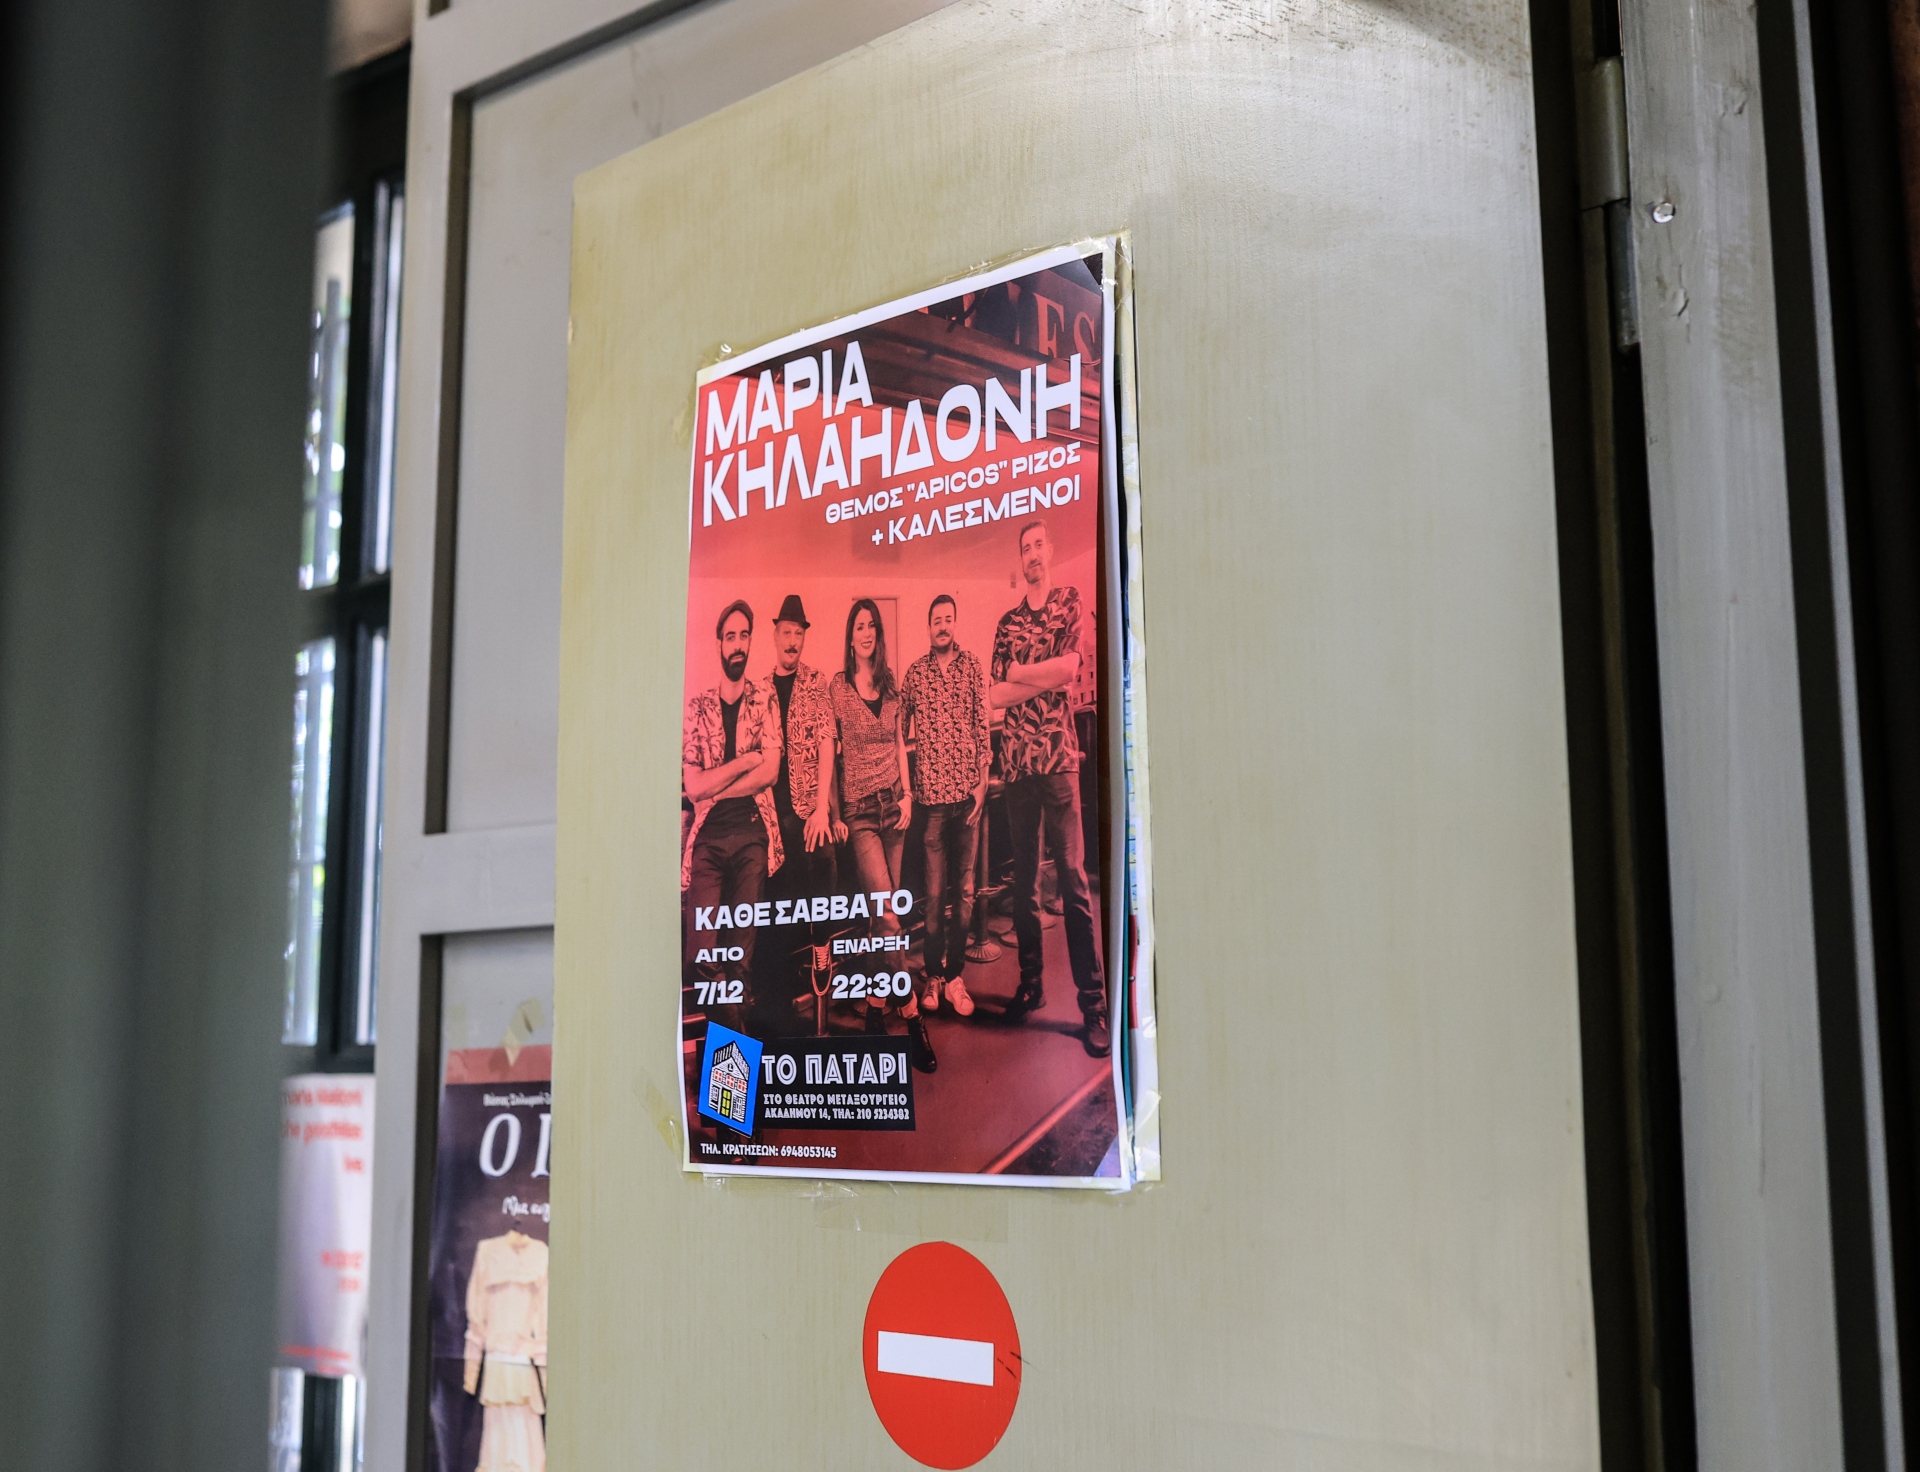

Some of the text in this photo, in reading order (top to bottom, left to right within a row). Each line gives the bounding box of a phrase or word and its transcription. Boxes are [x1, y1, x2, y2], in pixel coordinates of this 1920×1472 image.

[705, 340, 873, 456] ΜΑΡΙΑ
[703, 353, 1081, 528] ΚΗΛΑΗΔΟΝΗ
[825, 487, 904, 524] ΘΕΜΟΣ
[1012, 441, 1081, 479] ΡΙΖΟΣ
[872, 474, 1081, 546] + ΚΑΛΕΣΜΕΝΟΙ
[695, 889, 913, 931] ΚΑΘΕ ΣΑΒΒΑΤΟ
[694, 947, 744, 963] ΑΠΟ
[832, 935, 910, 955] ΕΝΑΡΞΗ
[694, 980, 744, 1005] 7/12
[832, 971, 912, 1000] 22:30
[762, 1052, 907, 1085] ΤΟ ΠΑΤΑΡΙ
[763, 1093, 908, 1105] ΣΤΟ ΘΕΑΤΡΟ ΜΕΤΑΞΟΥΡΓΕΙΟ
[765, 1107, 817, 1119] ΑΚΑΔΗΜΟΥ
[818, 1108, 831, 1120] 14,
[832, 1108, 855, 1119] ΤΗΛ:
[856, 1108, 872, 1120] 210
[700, 1143, 837, 1158] ΤΗΛ. ΚΡΑΤΗΣΕΩΝ: 6948053145
